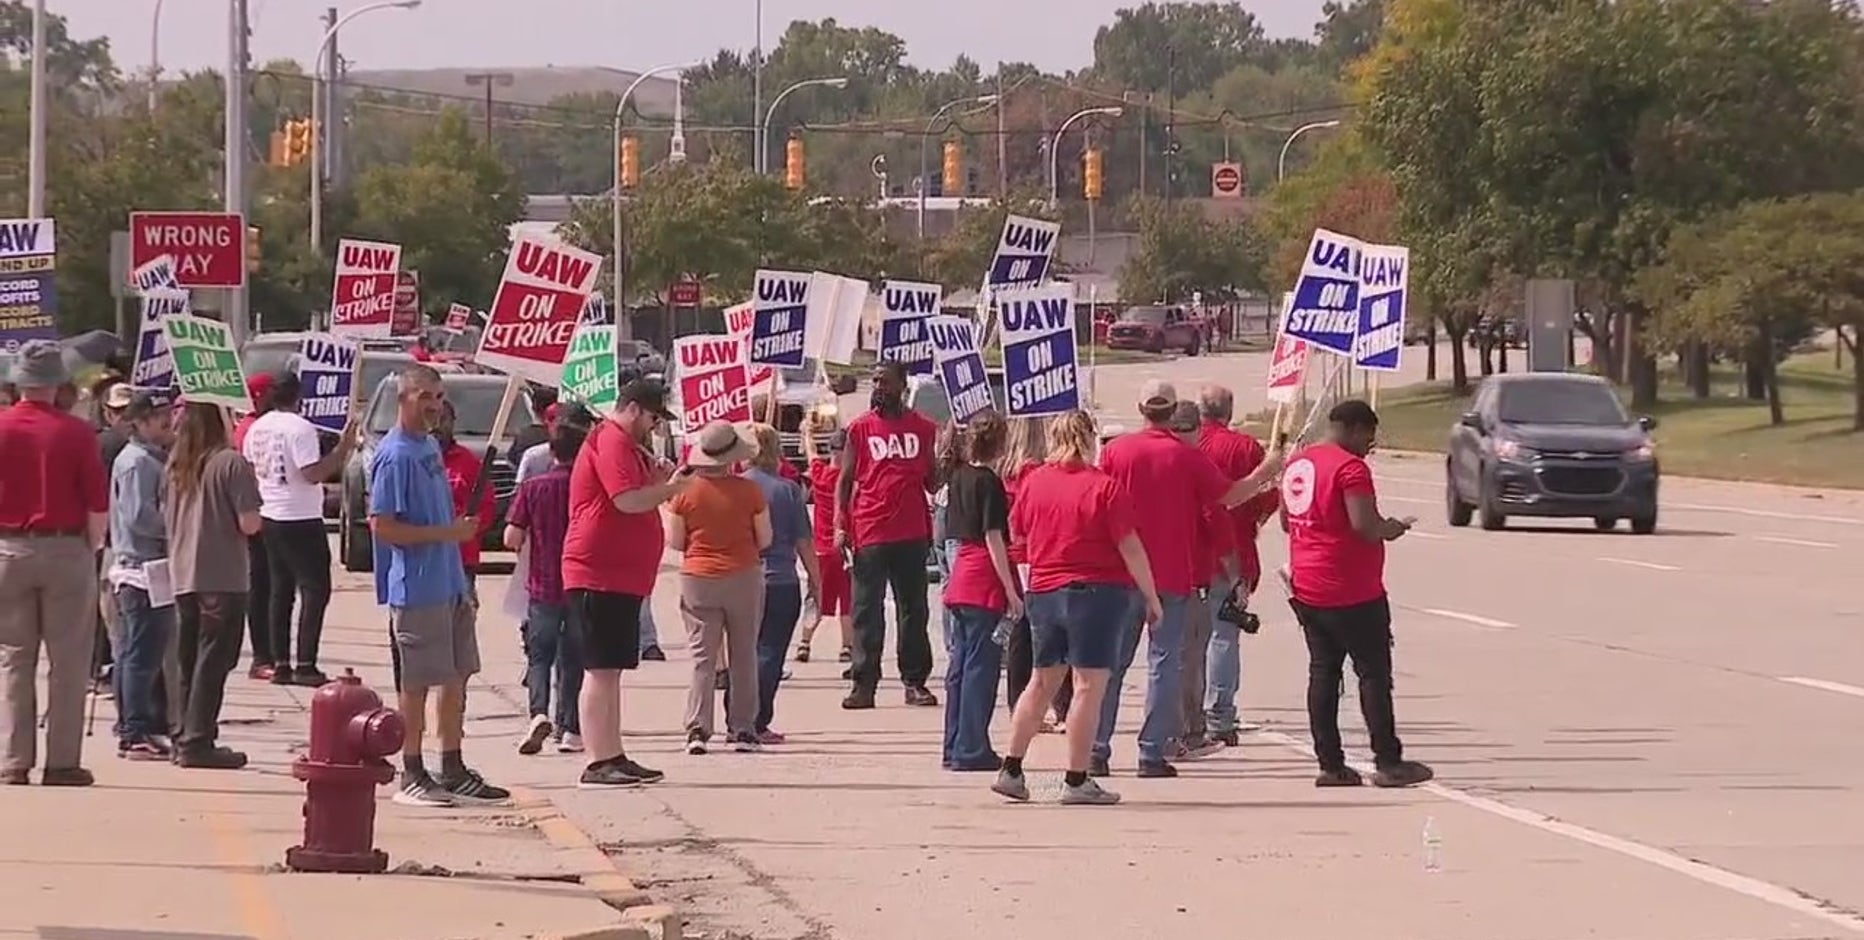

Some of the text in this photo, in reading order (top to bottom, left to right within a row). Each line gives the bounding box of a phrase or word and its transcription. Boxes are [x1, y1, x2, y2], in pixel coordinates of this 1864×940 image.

[0, 224, 39, 252] AW
[144, 225, 231, 247] WRONG
[1005, 223, 1054, 253] UAW
[0, 260, 23, 271] ND
[172, 253, 213, 275] AY
[343, 246, 395, 271] UAW
[516, 241, 594, 290] UAW
[1008, 259, 1031, 280] ON
[1363, 256, 1405, 286] UAW
[0, 279, 40, 292] CORD
[140, 262, 170, 291] UAW
[351, 276, 376, 297] ON
[0, 291, 41, 304] OFITS
[758, 278, 807, 303] UAW
[886, 289, 936, 314] UAW
[1318, 282, 1350, 308] ON
[0, 305, 40, 317] CORD
[147, 298, 185, 320] UAW
[334, 292, 393, 323] STRIKE
[519, 293, 557, 321] ON
[1001, 299, 1068, 332] UAW
[0, 315, 53, 330] TRACTS
[770, 310, 790, 334] ON
[900, 321, 919, 343] ON
[1288, 308, 1357, 333] STRIKE
[167, 321, 226, 348] UAW
[484, 320, 574, 349] STRIKE
[572, 331, 612, 353] AW
[752, 330, 803, 360] STRIKE
[930, 323, 974, 350] UAW
[193, 350, 218, 369] ON
[306, 339, 356, 369] UAW
[680, 341, 738, 366] UAW
[883, 342, 934, 363] STRIKE
[1027, 340, 1053, 373] ON
[181, 369, 242, 392] STRIKE
[574, 358, 597, 383] ON
[956, 359, 974, 389] ON
[316, 374, 338, 396] ON
[699, 372, 725, 400] ON
[1011, 363, 1075, 410] STRIKE
[301, 396, 350, 417] STRIKE
[686, 385, 748, 431] STRIKE
[953, 383, 991, 420] STRIKE
[868, 432, 919, 461] DAD
